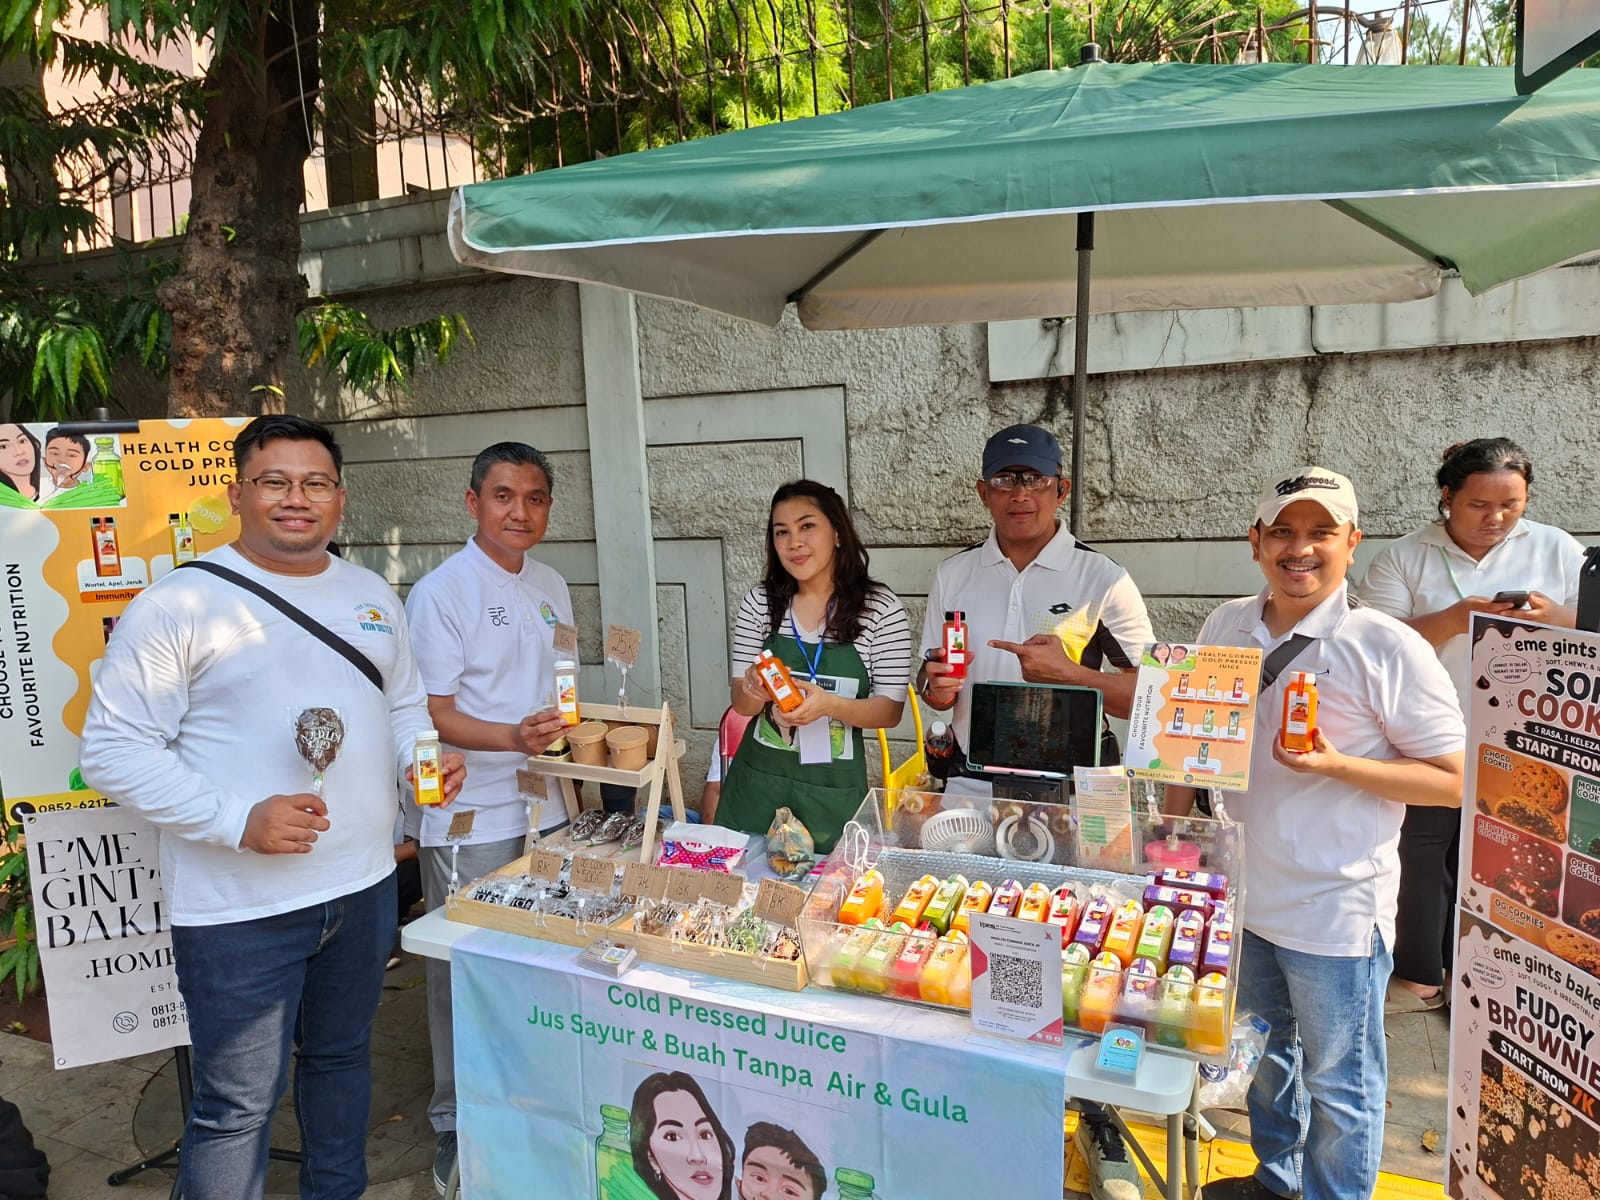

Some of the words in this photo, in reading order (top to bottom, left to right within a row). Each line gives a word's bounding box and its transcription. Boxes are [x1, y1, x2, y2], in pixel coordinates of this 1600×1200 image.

[123, 441, 200, 455] HEALTH
[139, 458, 194, 471] COLD
[6, 563, 31, 653] NUTRITION
[95, 591, 135, 601] Immunity
[1515, 639, 1547, 652] eme
[1552, 639, 1597, 659] gints
[19, 657, 45, 747] FAVOURITE
[1516, 735, 1558, 759] START
[1540, 727, 1563, 741] RASA,
[1484, 757, 1513, 771] COOKIES
[1485, 749, 1511, 763] CHOCO
[38, 798, 108, 814] 0852-6217
[1571, 858, 1595, 873] OREO
[42, 867, 163, 911] GINT'
[1495, 899, 1507, 911] OG
[1508, 905, 1545, 929] COOKIES
[1494, 945, 1521, 964] eme
[1525, 957, 1562, 983] gints
[607, 985, 661, 1015] Cold
[668, 998, 767, 1037] Pressed
[774, 1020, 847, 1054] Juice
[1516, 986, 1595, 1051] FUDGY
[1488, 997, 1600, 1092] BROWNIE
[527, 1005, 564, 1031] Jus
[571, 1013, 635, 1046] Sayur
[642, 1029, 658, 1052] &
[665, 1034, 727, 1067] Buah
[733, 1049, 813, 1088] Tanpa
[827, 1071, 866, 1100] Air
[873, 1082, 893, 1107] &
[901, 1088, 968, 1124] Gula
[1501, 1039, 1533, 1072] START
[1536, 1066, 1569, 1098] FROM
[1571, 1085, 1597, 1118] 7K
